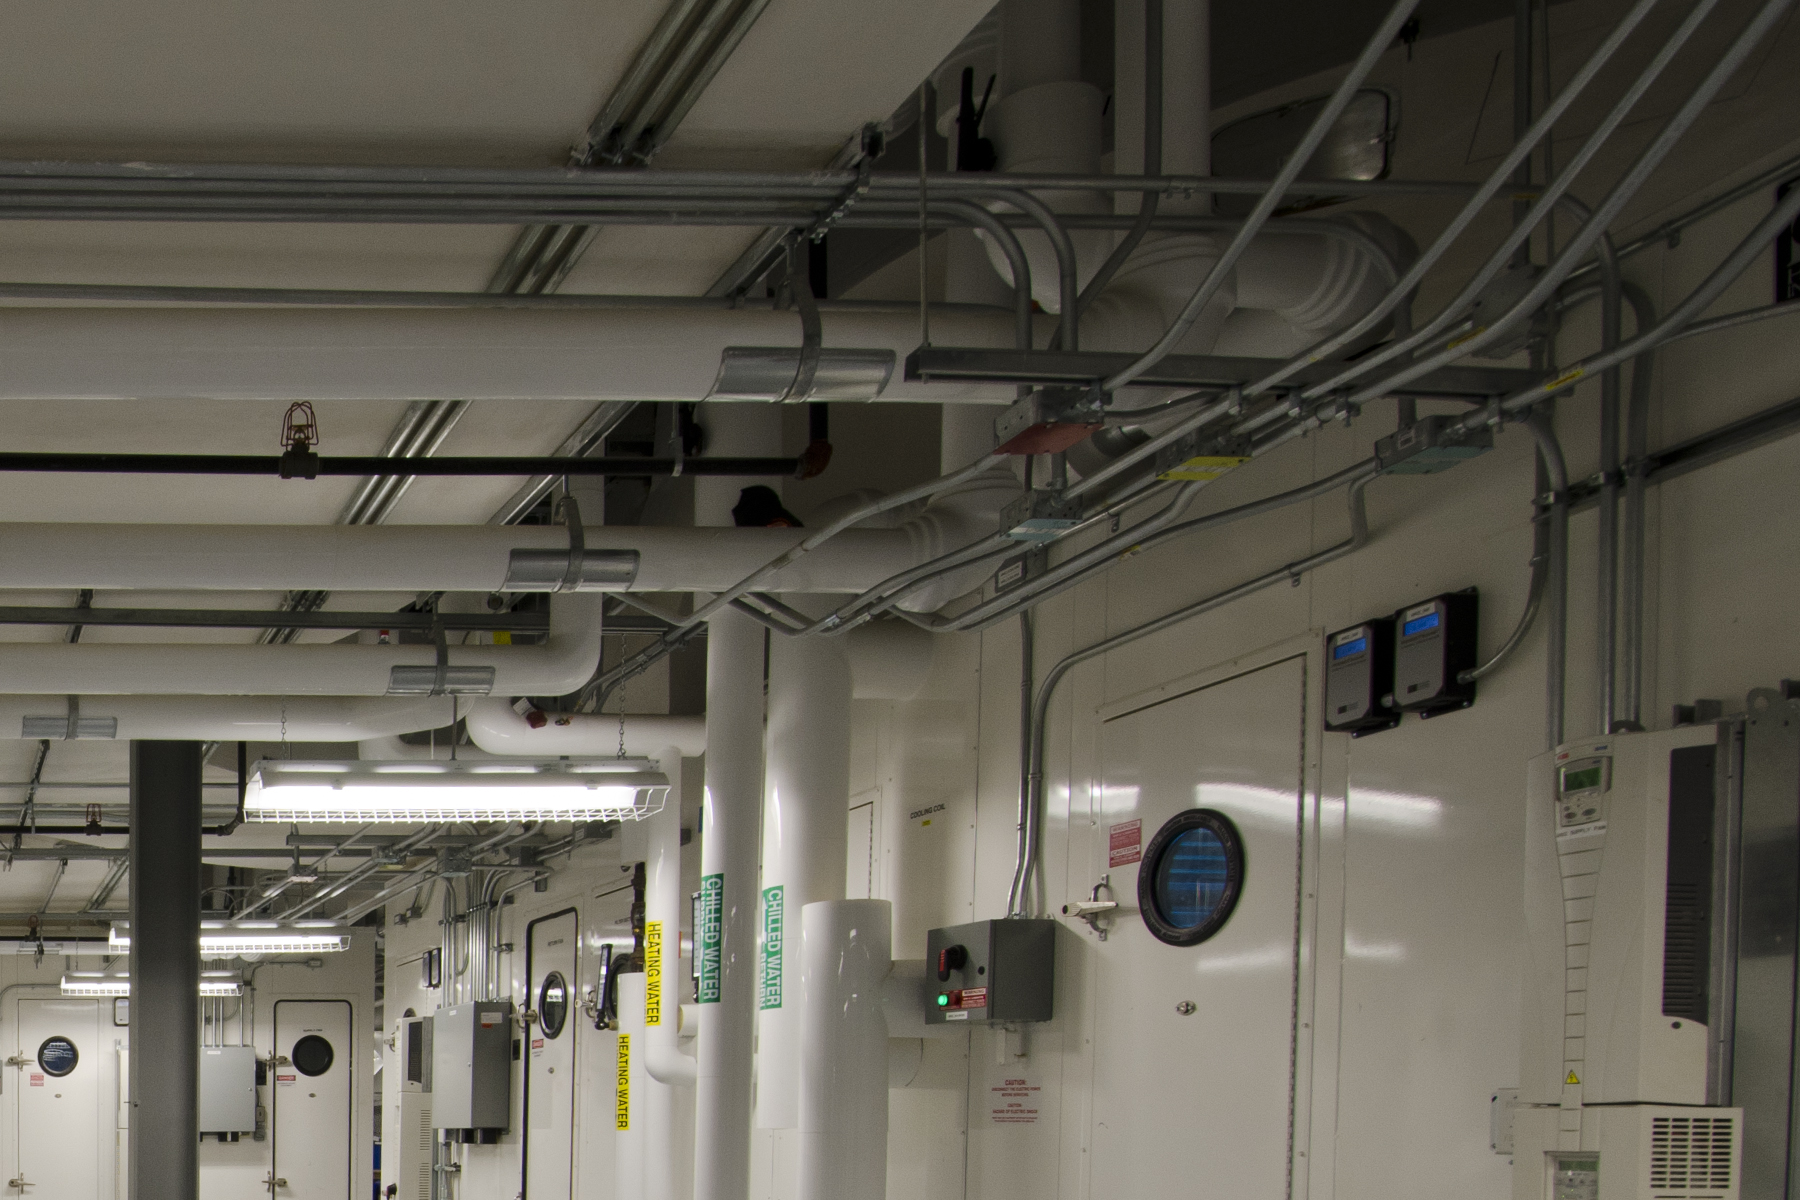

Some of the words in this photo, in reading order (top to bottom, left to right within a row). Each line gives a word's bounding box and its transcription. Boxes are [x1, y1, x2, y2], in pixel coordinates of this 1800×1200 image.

[910, 807, 933, 819] COOLING
[705, 878, 722, 943] CHILLED
[768, 890, 782, 952] CHILLED
[648, 924, 661, 977] HEATING
[704, 946, 720, 1000] WATER
[647, 981, 660, 1024] WATER
[766, 954, 781, 1006] WATER
[618, 1036, 628, 1085] HEATING
[617, 1089, 628, 1128] WATER
